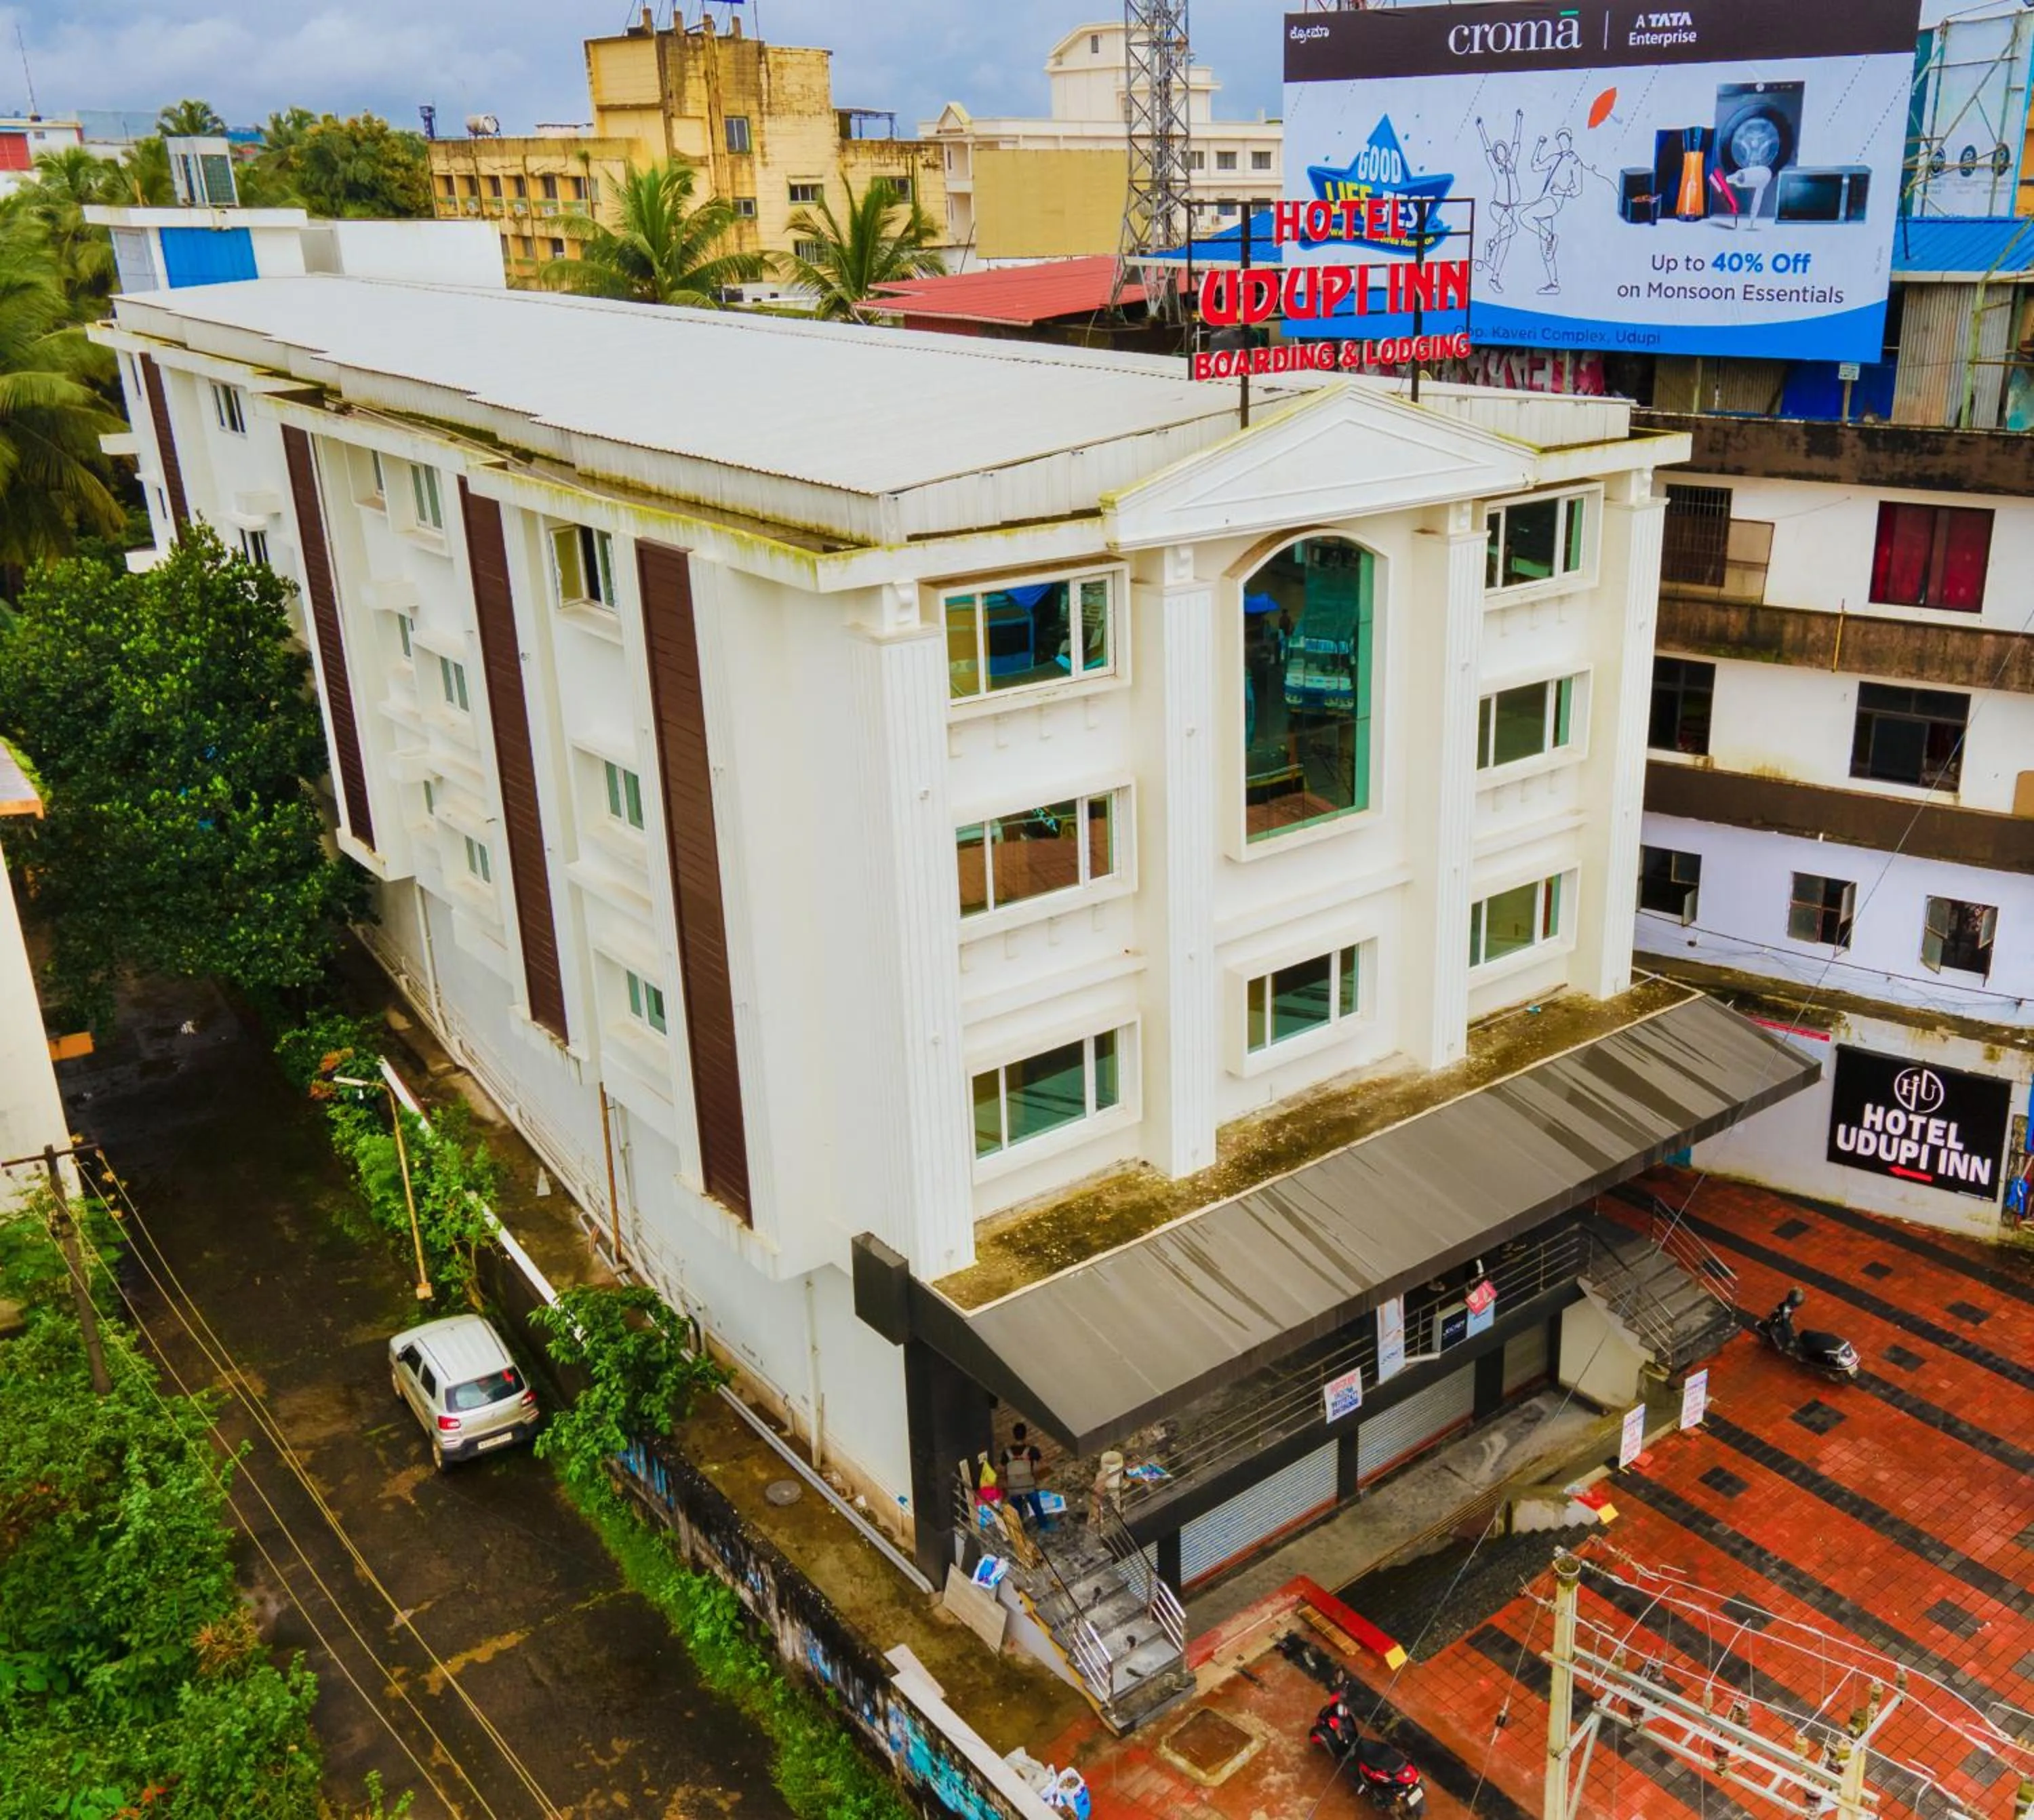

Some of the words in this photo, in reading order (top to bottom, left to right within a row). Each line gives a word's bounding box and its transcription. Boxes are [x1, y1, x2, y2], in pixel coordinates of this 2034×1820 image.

[1629, 28, 1696, 48] Enterprise
[1635, 14, 1646, 28] A
[1648, 12, 1692, 28] TATA
[1357, 144, 1402, 184] GOOD
[1275, 199, 1407, 247] HOTEL
[1652, 254, 1678, 275] Up
[1685, 256, 1705, 272] to
[1711, 252, 1763, 273] 40%
[1771, 252, 1812, 274] Off
[1198, 263, 1369, 326] UDUPI
[1386, 259, 1469, 314] INN
[1617, 283, 1640, 298] on
[1647, 281, 1736, 301] Monsoon
[1742, 283, 1845, 304] Essentials
[1492, 327, 1537, 340] Kaveri
[1541, 327, 1610, 344] Complex,
[1616, 330, 1660, 346] Udupi
[1193, 342, 1336, 382] BOARDING
[1340, 340, 1359, 368] &
[1363, 332, 1472, 366] LODGING
[1862, 1103, 1964, 1151] HOTEL
[1836, 1124, 1930, 1170] UDUPI
[1937, 1147, 1993, 1186] INN
